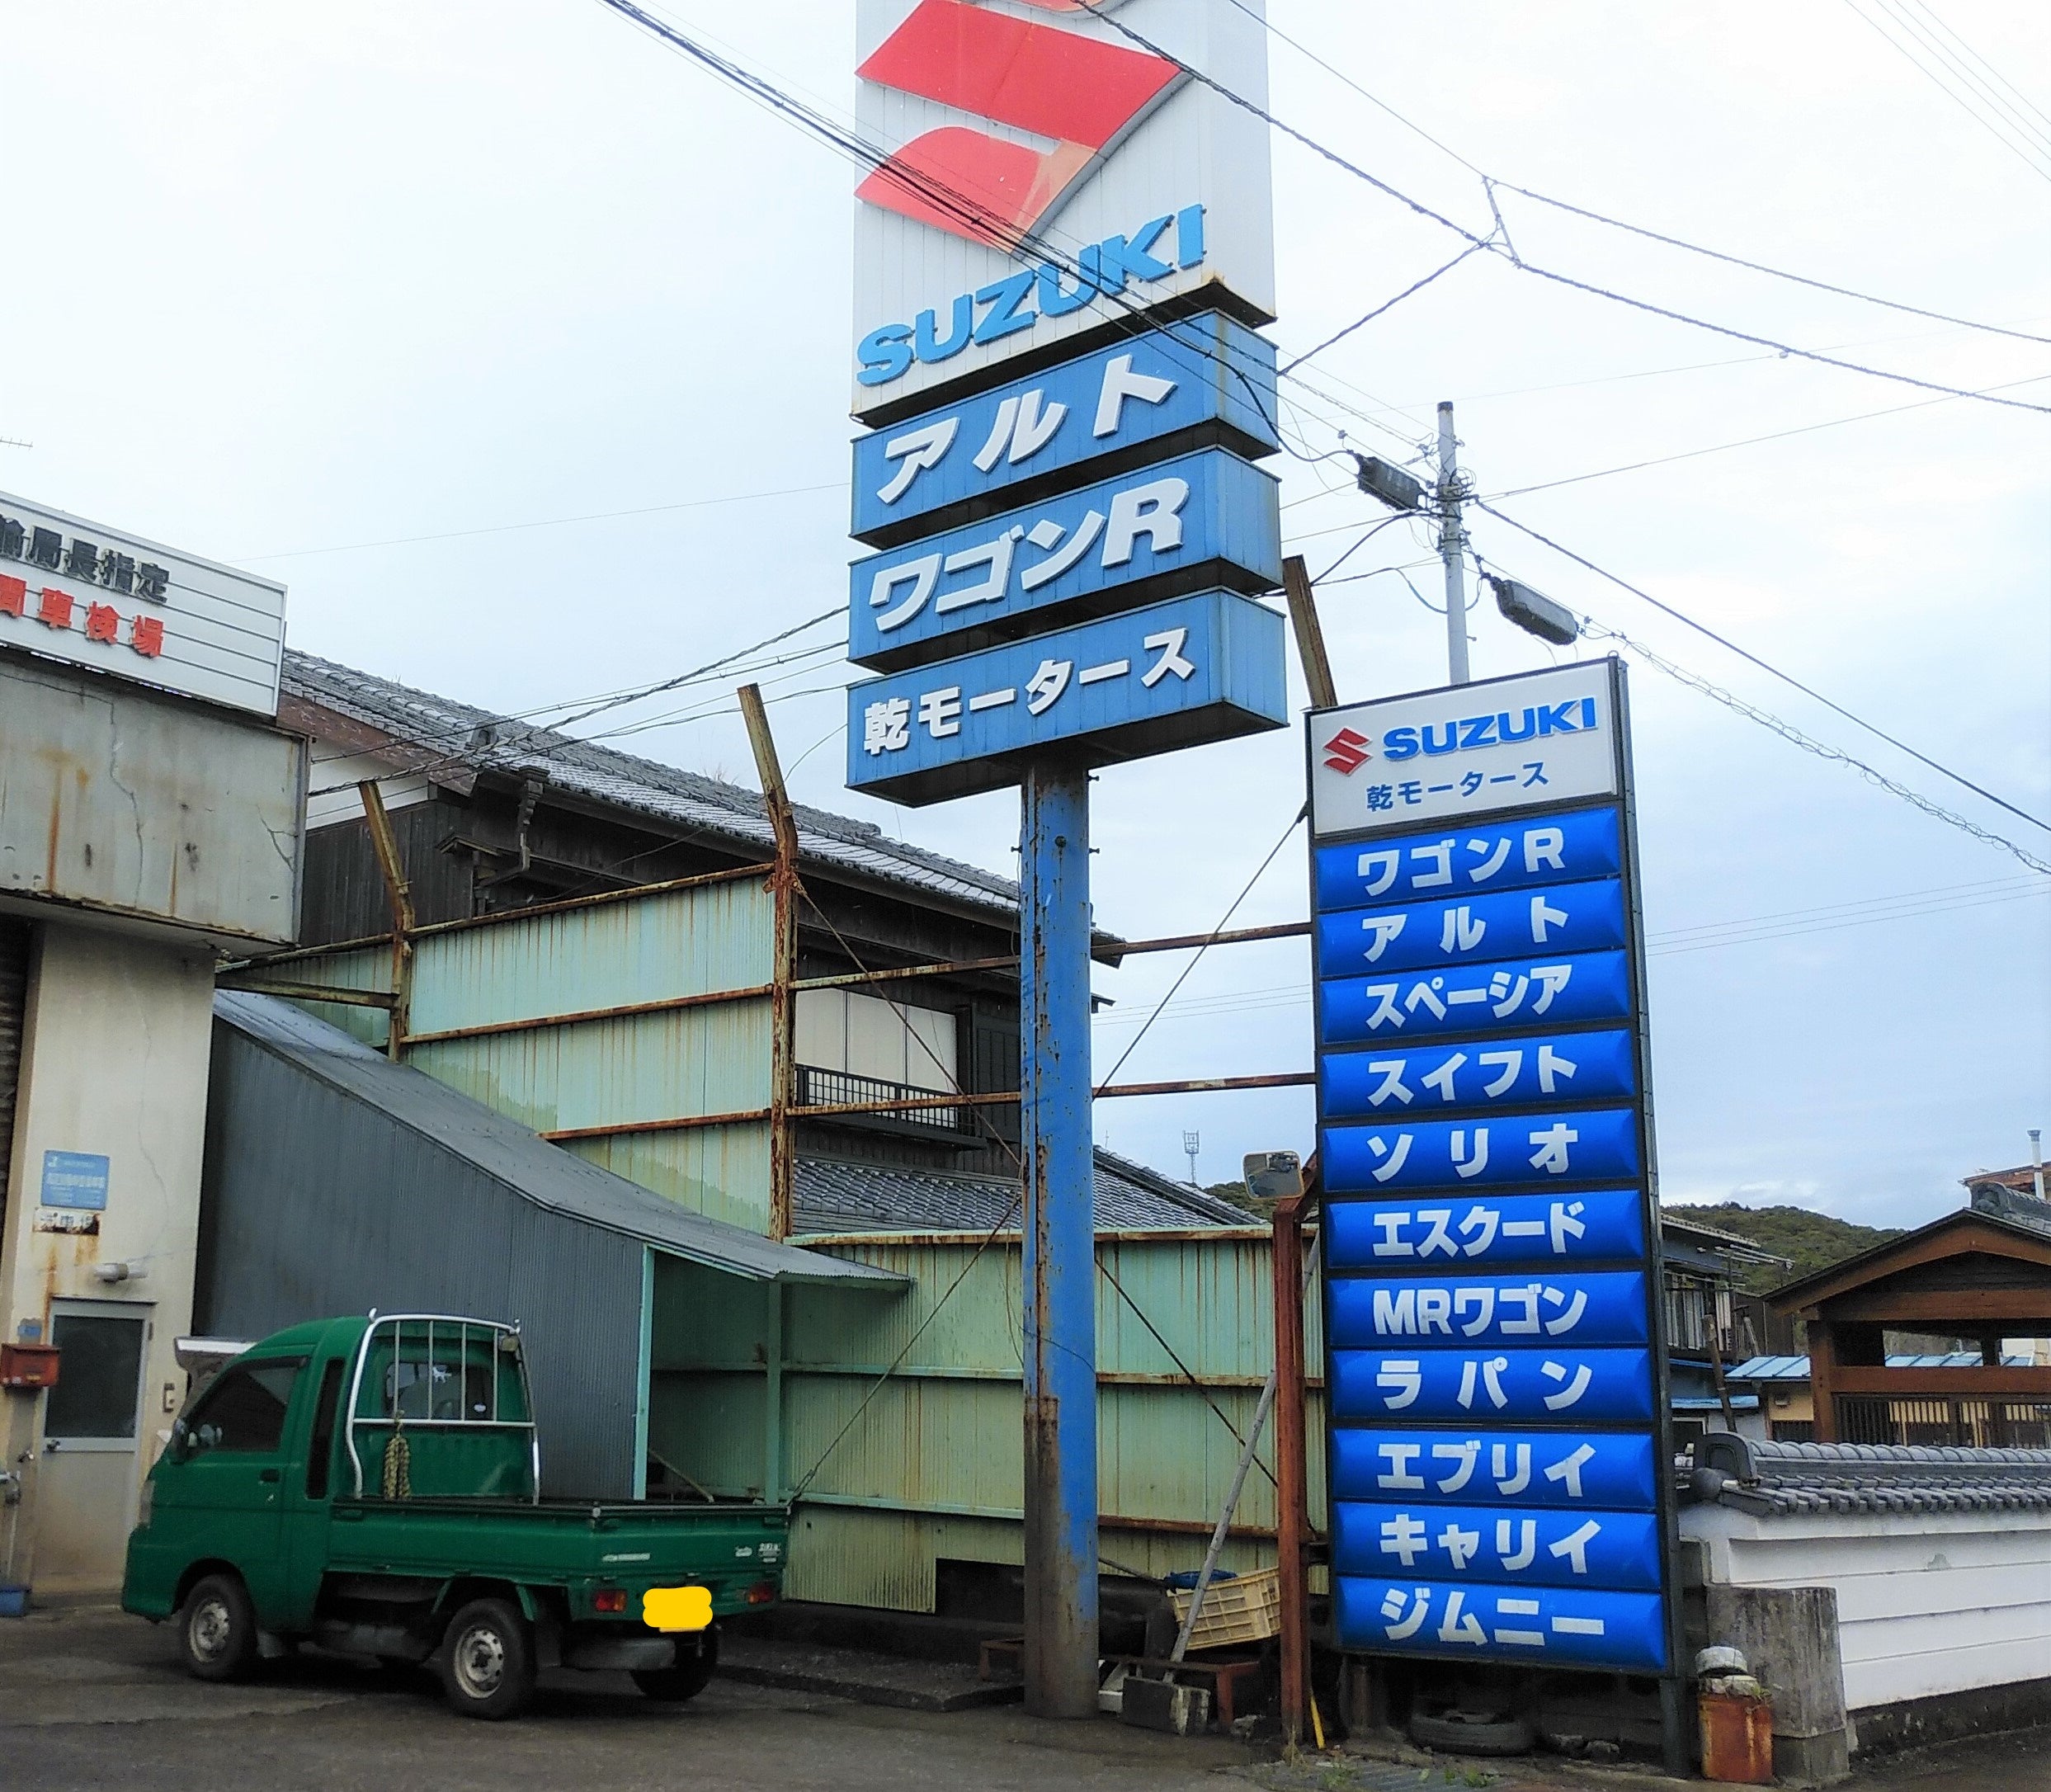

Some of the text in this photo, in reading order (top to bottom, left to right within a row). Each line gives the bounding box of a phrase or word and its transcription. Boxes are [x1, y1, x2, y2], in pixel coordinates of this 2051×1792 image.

[856, 203, 1207, 388] SUZUKI
[876, 354, 1178, 506] アルト
[869, 478, 1191, 632] ワゴンR
[863, 627, 1195, 756] 乾モータース
[1383, 696, 1598, 762] SUZUKI
[1365, 761, 1549, 813] 乾モータース
[1357, 827, 1566, 897] ワゴンR
[1361, 896, 1568, 964] アルト
[1365, 964, 1572, 1030] スペーシア
[1367, 1045, 1578, 1106] スイフト
[1366, 1122, 1579, 1183] ソリオ
[1372, 1200, 1587, 1259] エスクード
[1372, 1282, 1588, 1337] MRワゴン
[1376, 1356, 1592, 1411] ラパン
[1379, 1587, 1605, 1647] ジムニー
